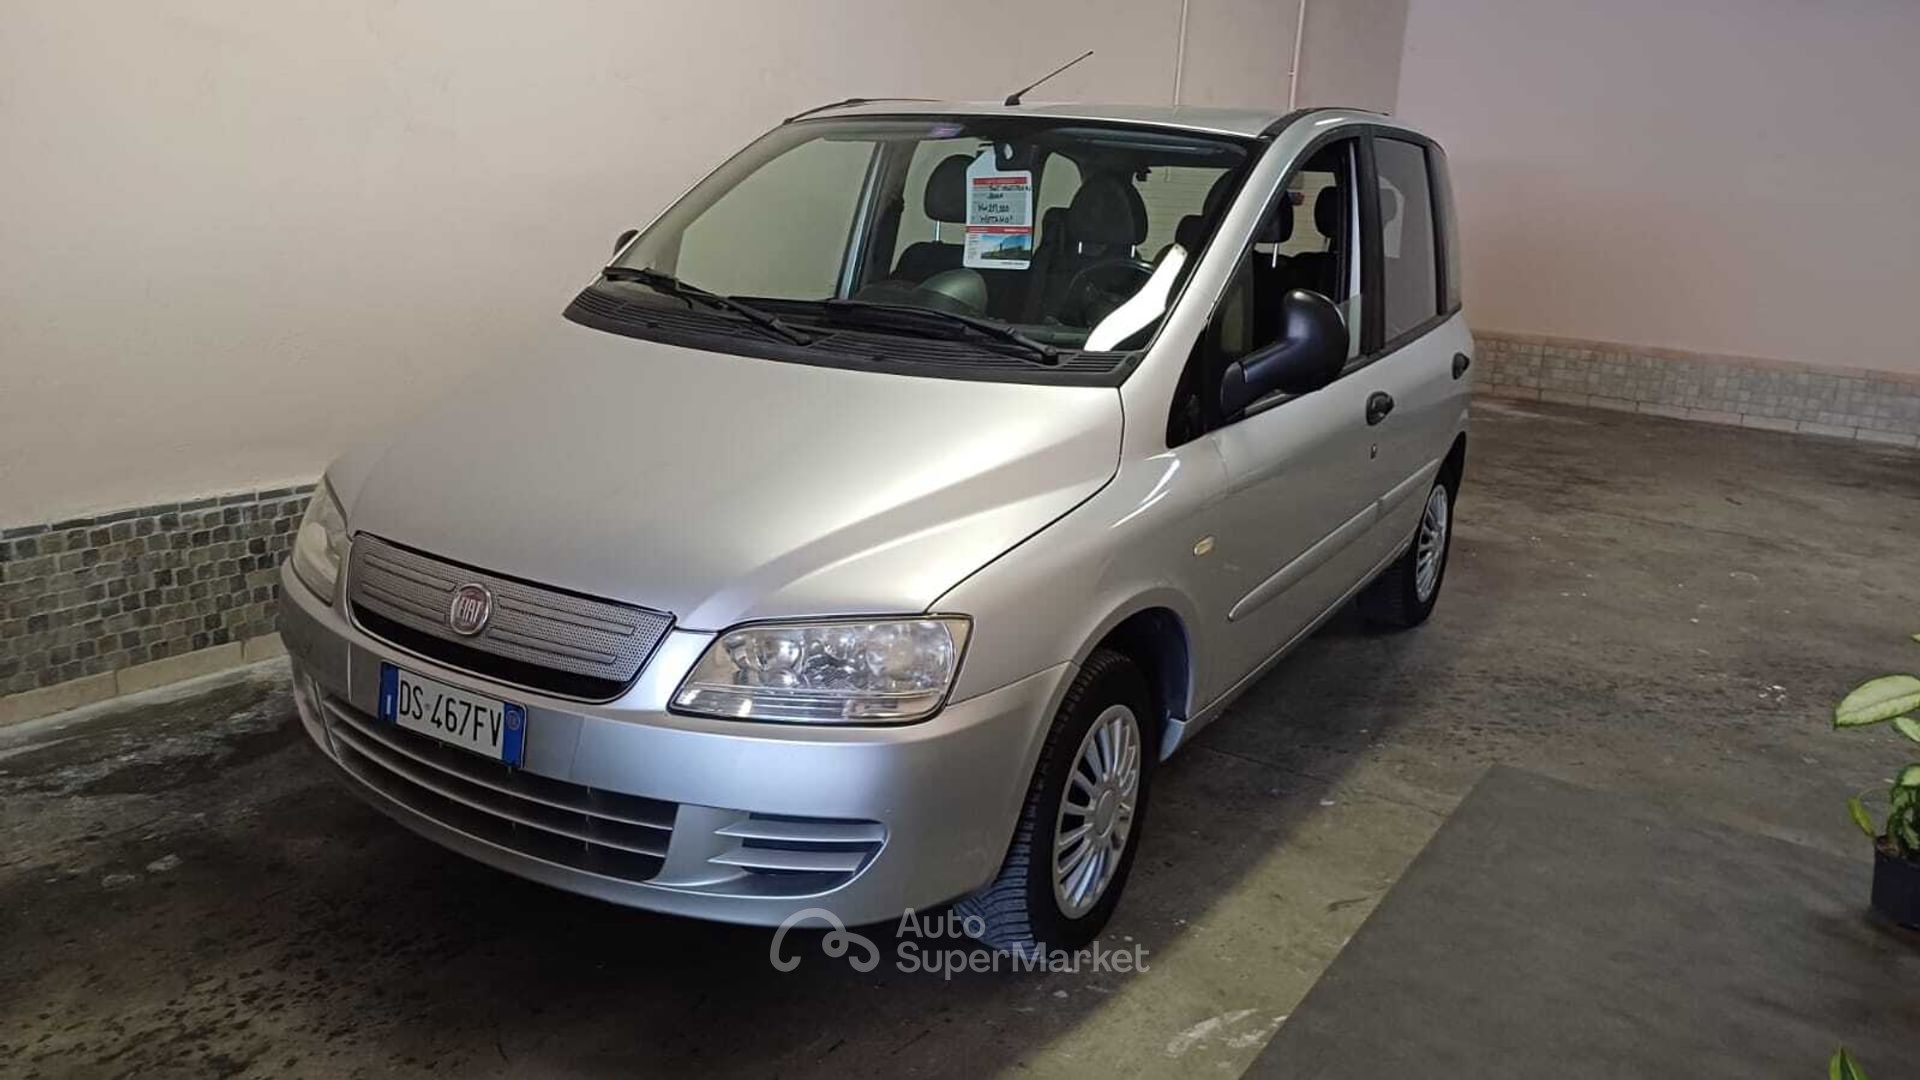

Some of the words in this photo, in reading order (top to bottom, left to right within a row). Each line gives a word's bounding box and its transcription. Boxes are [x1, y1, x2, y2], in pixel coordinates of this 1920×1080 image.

[458, 596, 482, 623] FIAT
[399, 680, 424, 721] DS
[430, 694, 502, 747] 467FV
